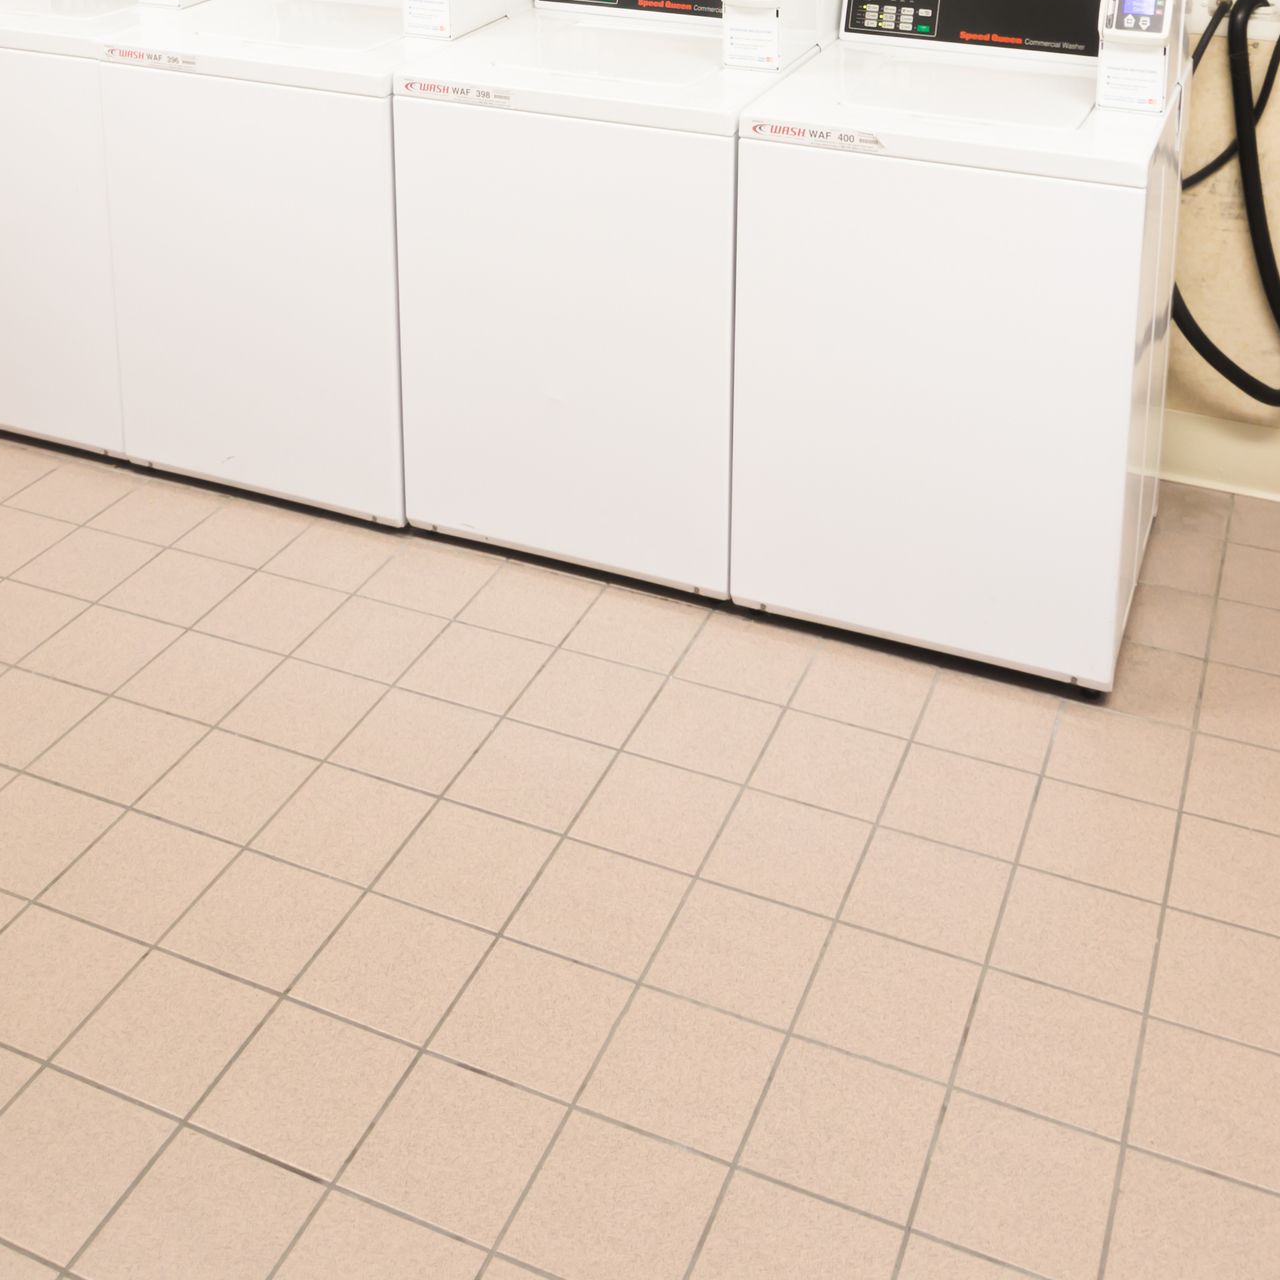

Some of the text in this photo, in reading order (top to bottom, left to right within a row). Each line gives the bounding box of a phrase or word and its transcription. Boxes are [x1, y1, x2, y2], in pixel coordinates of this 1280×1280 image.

[665, 0, 692, 11] Queen
[694, 4, 723, 13] Commercia
[959, 30, 1086, 51] Speed Queen Commercial Washer
[120, 49, 144, 59] WASH
[420, 83, 490, 98] WASH WAF 398
[770, 125, 855, 143] WASH WAF 400
